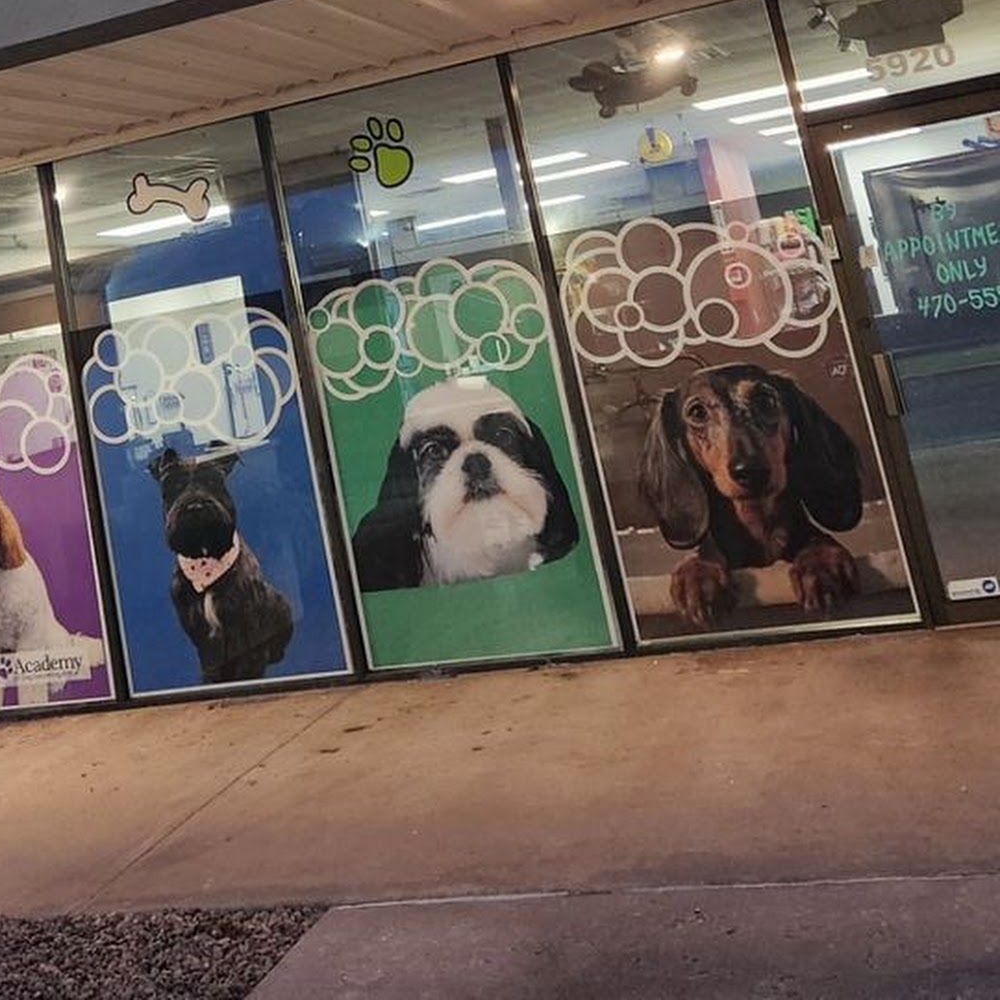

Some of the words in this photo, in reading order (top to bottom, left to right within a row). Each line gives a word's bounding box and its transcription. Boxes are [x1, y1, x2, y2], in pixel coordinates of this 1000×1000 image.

[866, 43, 956, 82] 5920
[936, 256, 987, 284] ONLY
[14, 654, 82, 675] Academy
